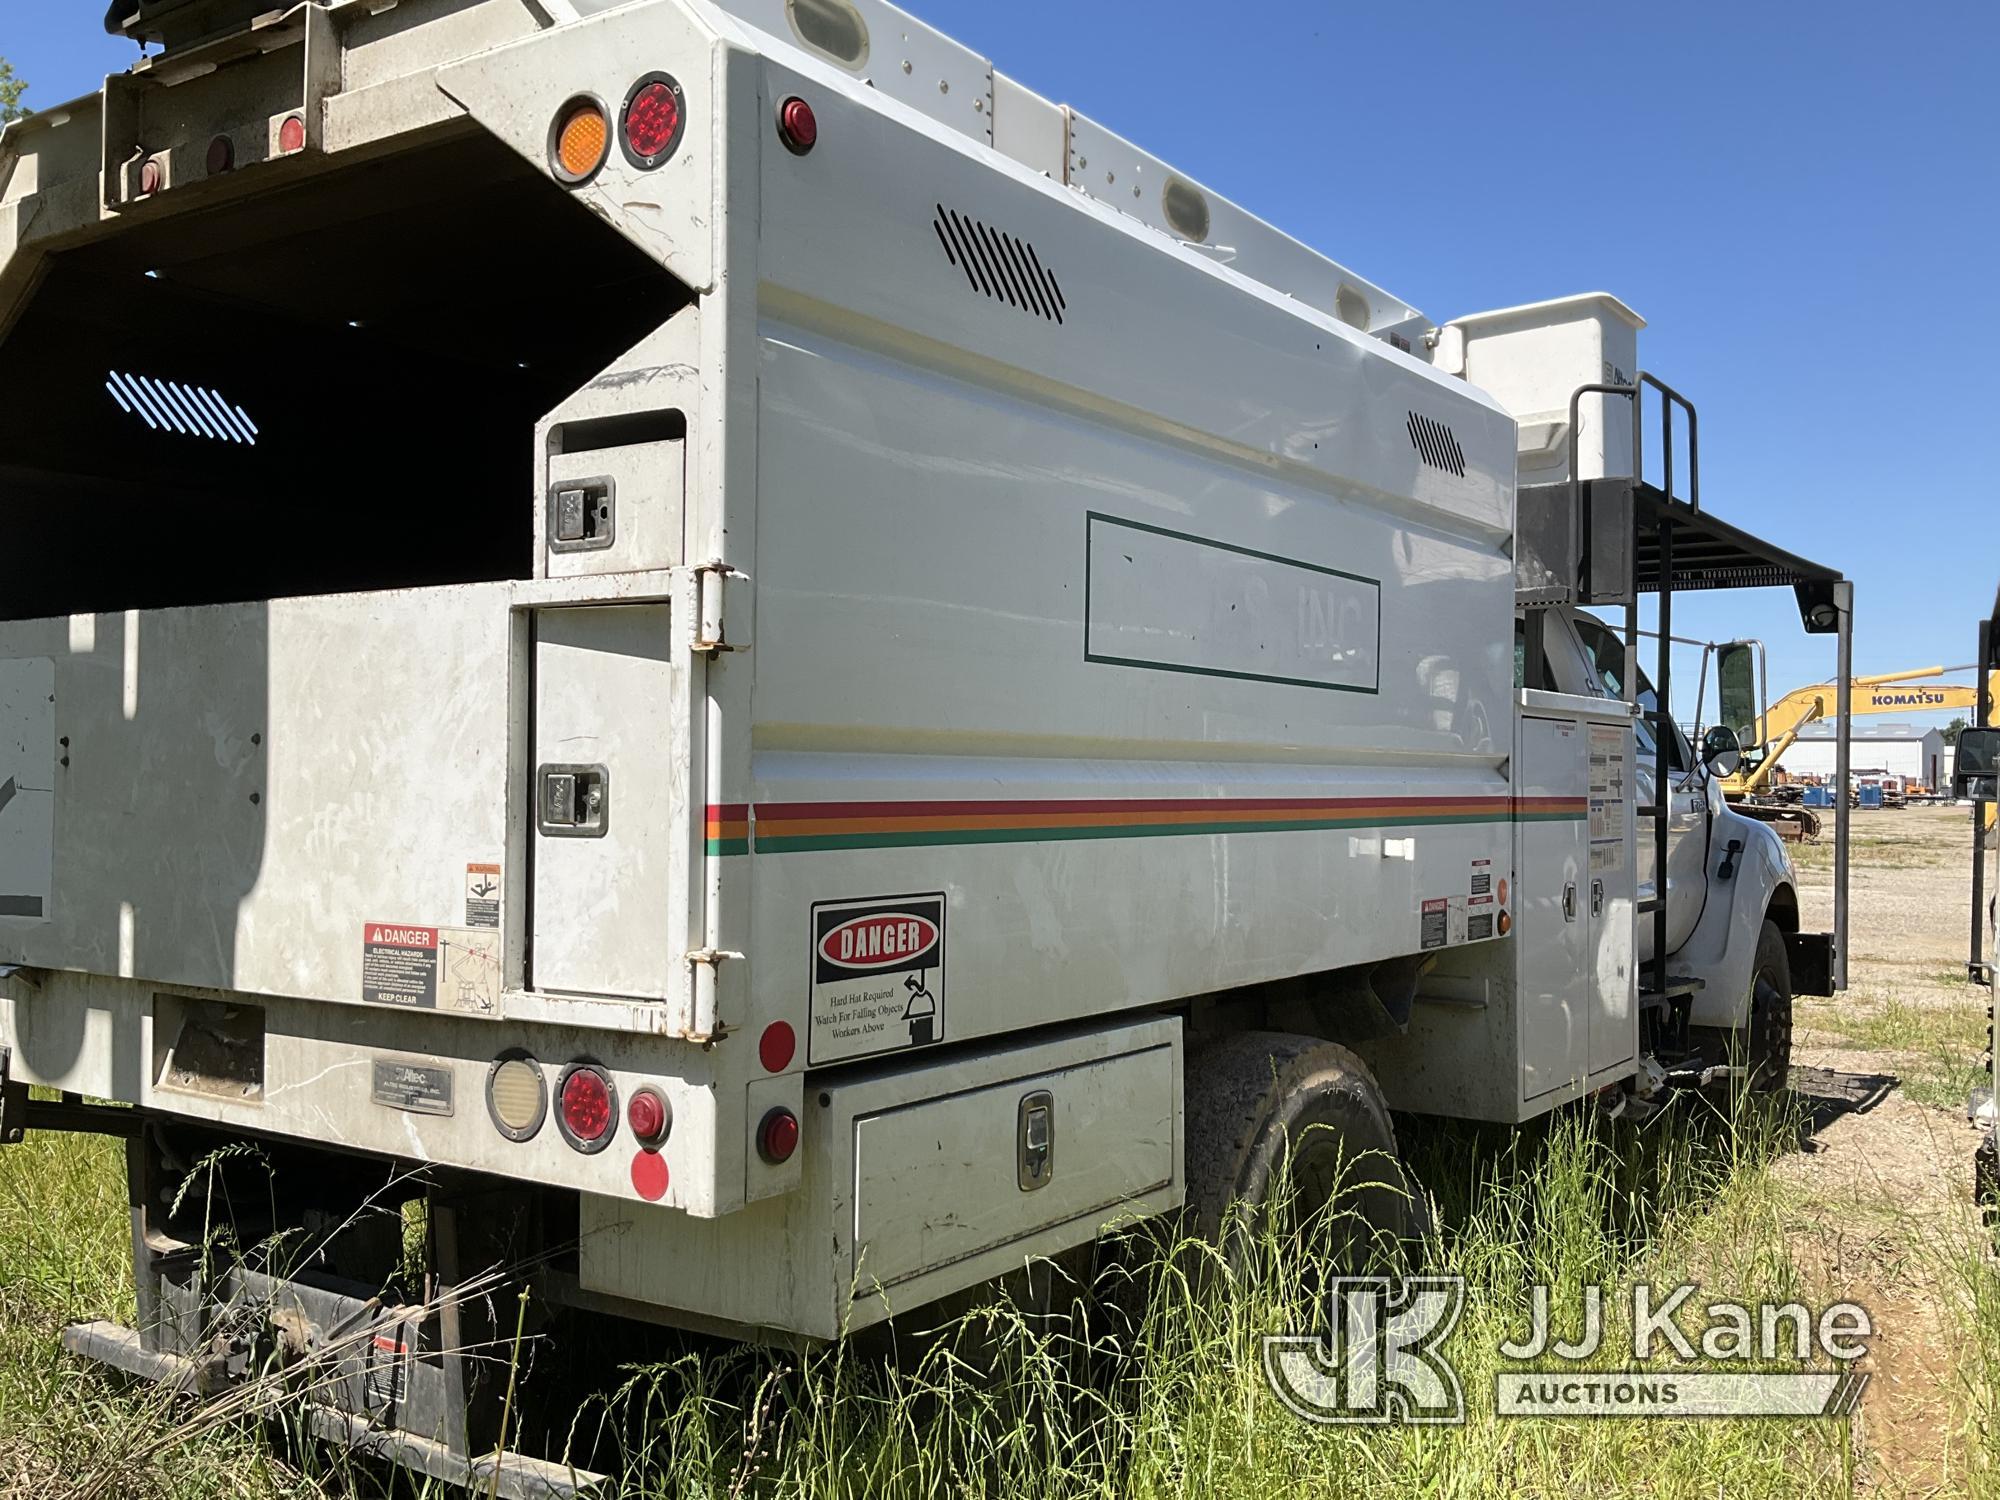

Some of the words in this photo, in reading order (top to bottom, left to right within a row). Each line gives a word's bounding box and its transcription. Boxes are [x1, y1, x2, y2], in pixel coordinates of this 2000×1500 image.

[1872, 692, 1944, 705] KOMATSU
[384, 928, 430, 945] DANGER
[841, 921, 920, 960] DANGER
[372, 947, 400, 956] ELECTRICAL
[378, 993, 395, 1002] KEEP
[395, 994, 417, 1004] CLEAR
[830, 994, 848, 1007] Hard
[849, 993, 862, 1004] Hat
[863, 987, 894, 1003] Required
[815, 1013, 837, 1025] Watch
[838, 1011, 851, 1025] For
[852, 1007, 877, 1019] Falling
[878, 1004, 904, 1016] Objects
[832, 1026, 860, 1039] Workers
[862, 1023, 885, 1034] Above
[403, 1068, 426, 1084] Altec
